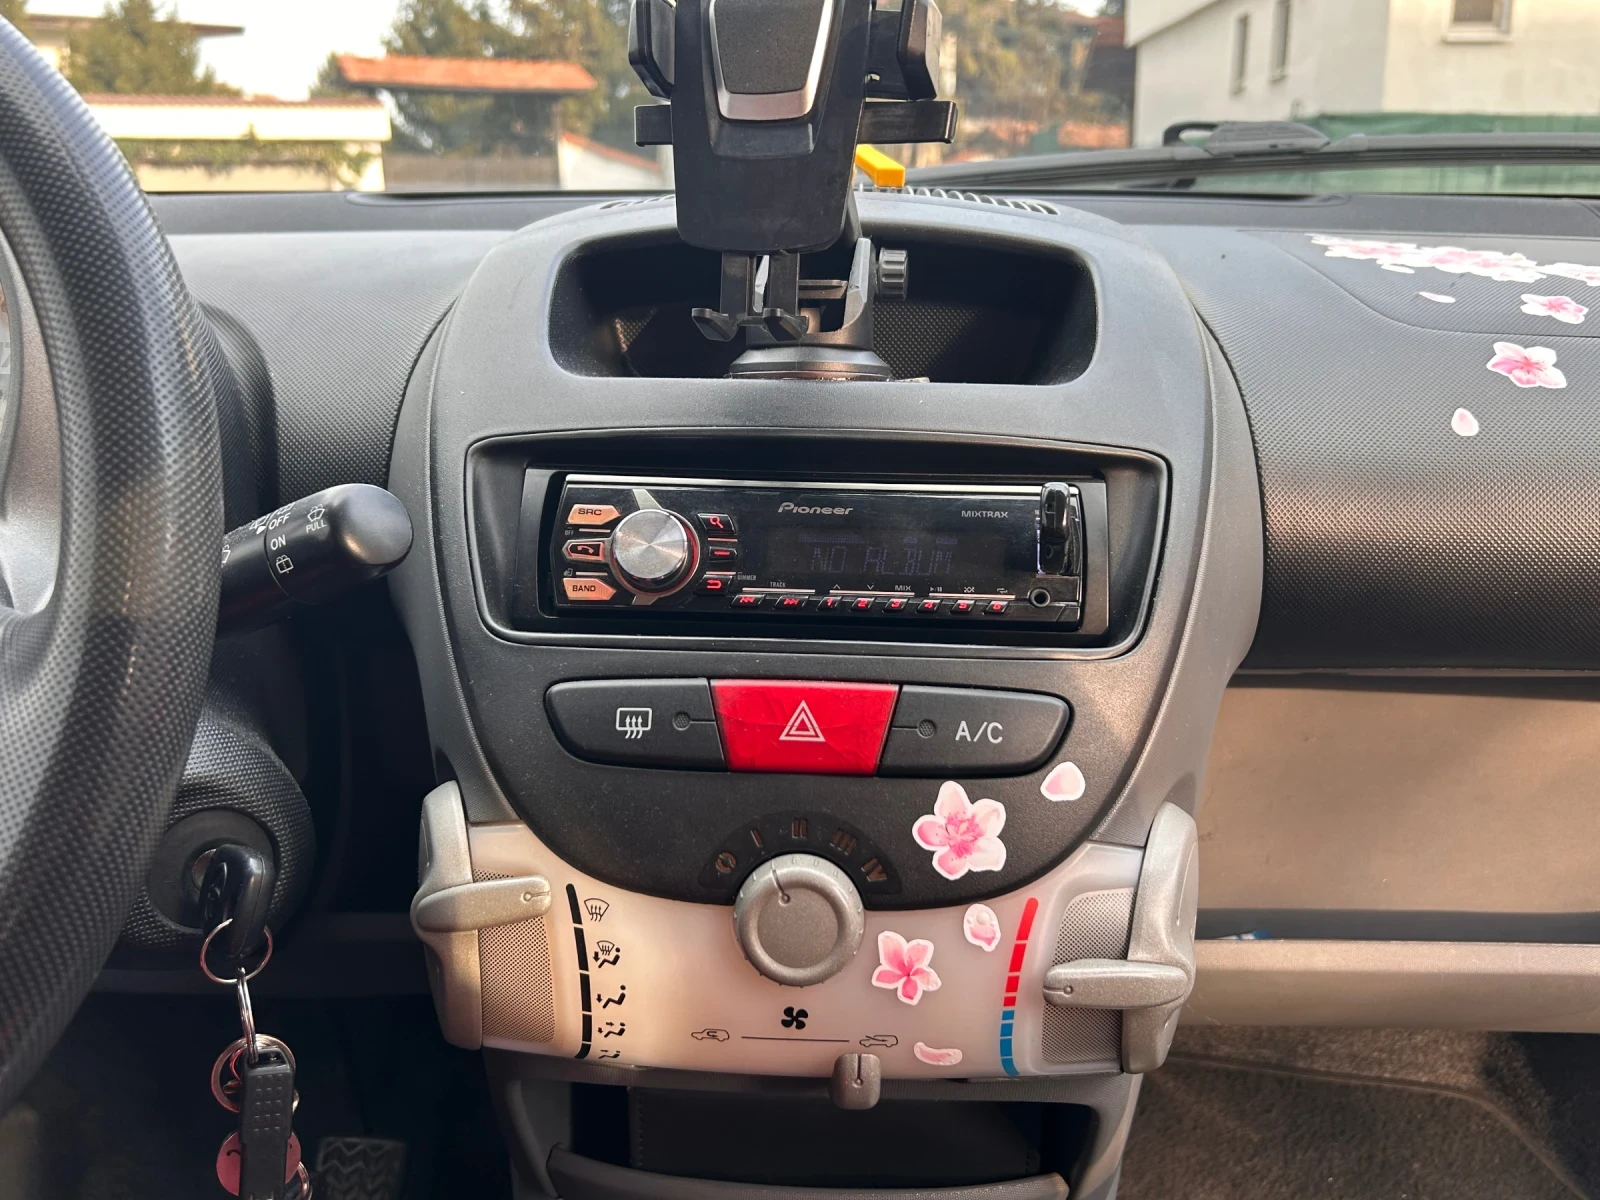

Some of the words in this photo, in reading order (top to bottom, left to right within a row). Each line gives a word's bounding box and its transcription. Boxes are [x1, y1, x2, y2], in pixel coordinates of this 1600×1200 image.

[578, 508, 603, 516] SRC
[778, 502, 854, 516] Pioneer
[961, 509, 1009, 519] MIXTRAX
[268, 512, 292, 530] OFF
[305, 520, 328, 534] PULL
[270, 534, 287, 551] ON
[810, 545, 848, 574] NO
[862, 546, 954, 576] ALBUM
[572, 584, 597, 593] BAND
[894, 584, 912, 592] MIX
[857, 599, 868, 607] 2
[924, 601, 934, 609] 4
[955, 720, 1004, 743] A/C
